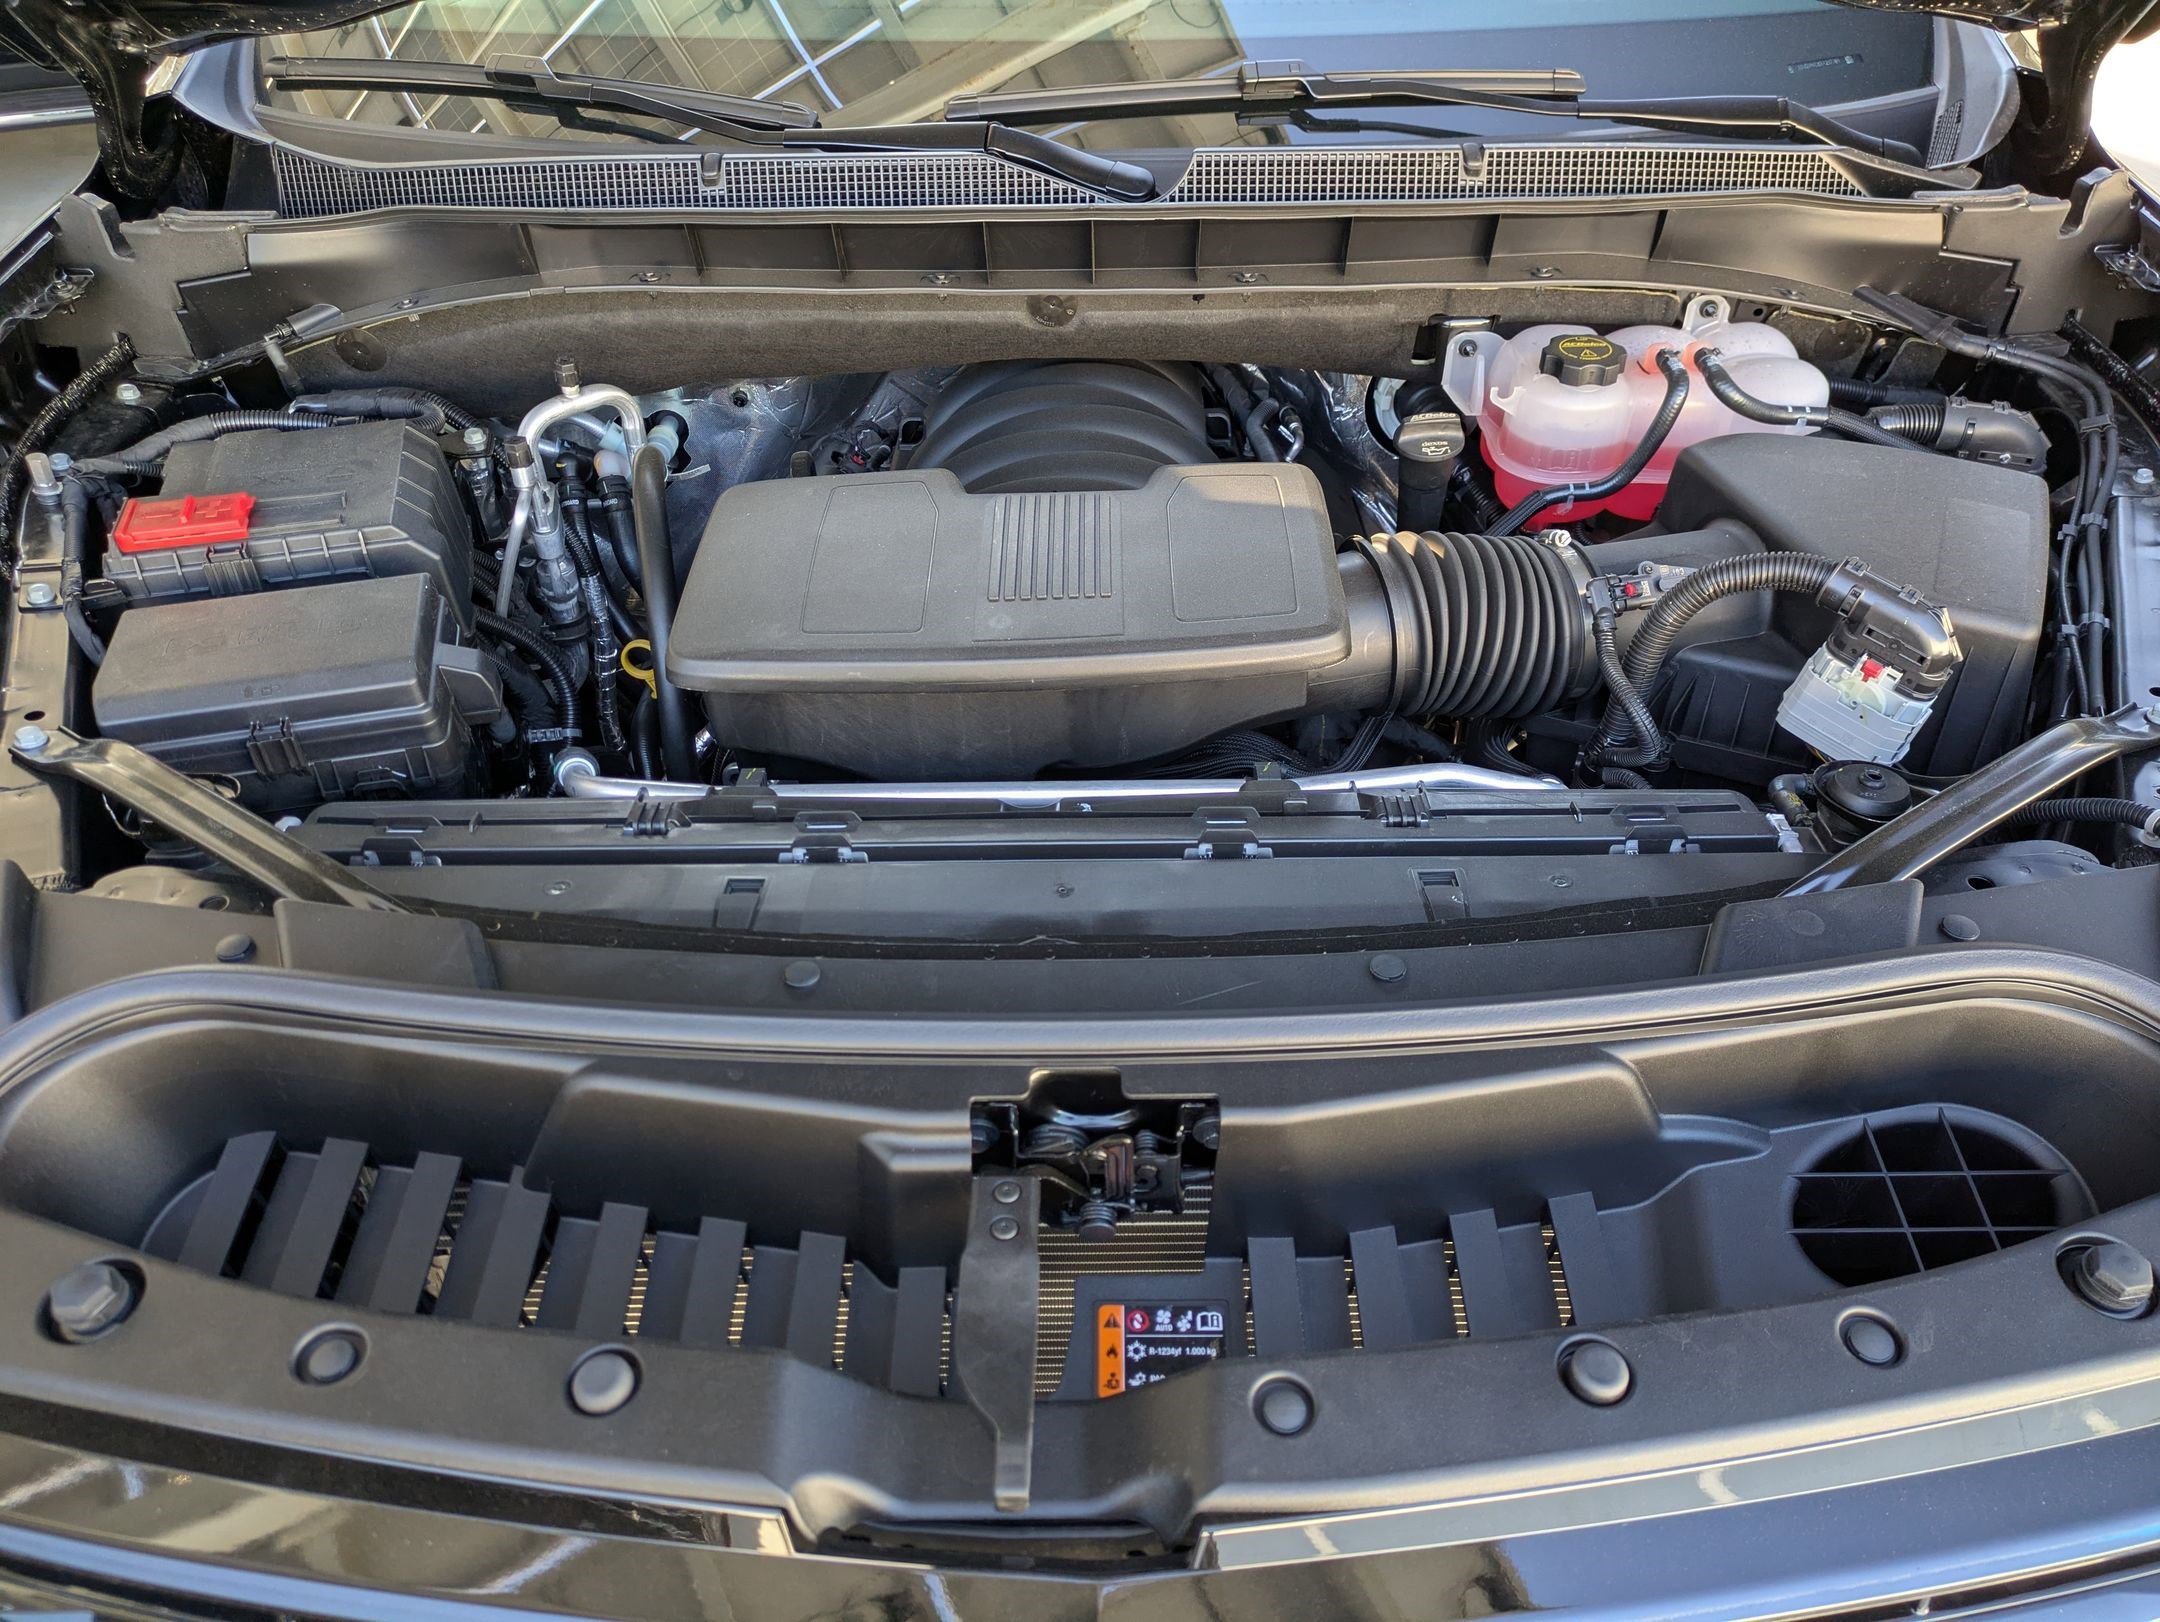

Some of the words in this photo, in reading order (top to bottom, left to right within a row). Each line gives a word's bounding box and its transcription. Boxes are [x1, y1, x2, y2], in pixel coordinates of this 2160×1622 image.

[1409, 412, 1456, 424] ACDelco
[1155, 1324, 1173, 1332] AUTO
[1149, 1347, 1182, 1357] R-1234yf
[1185, 1347, 1206, 1356] 1.000
[1207, 1347, 1217, 1357] kg
